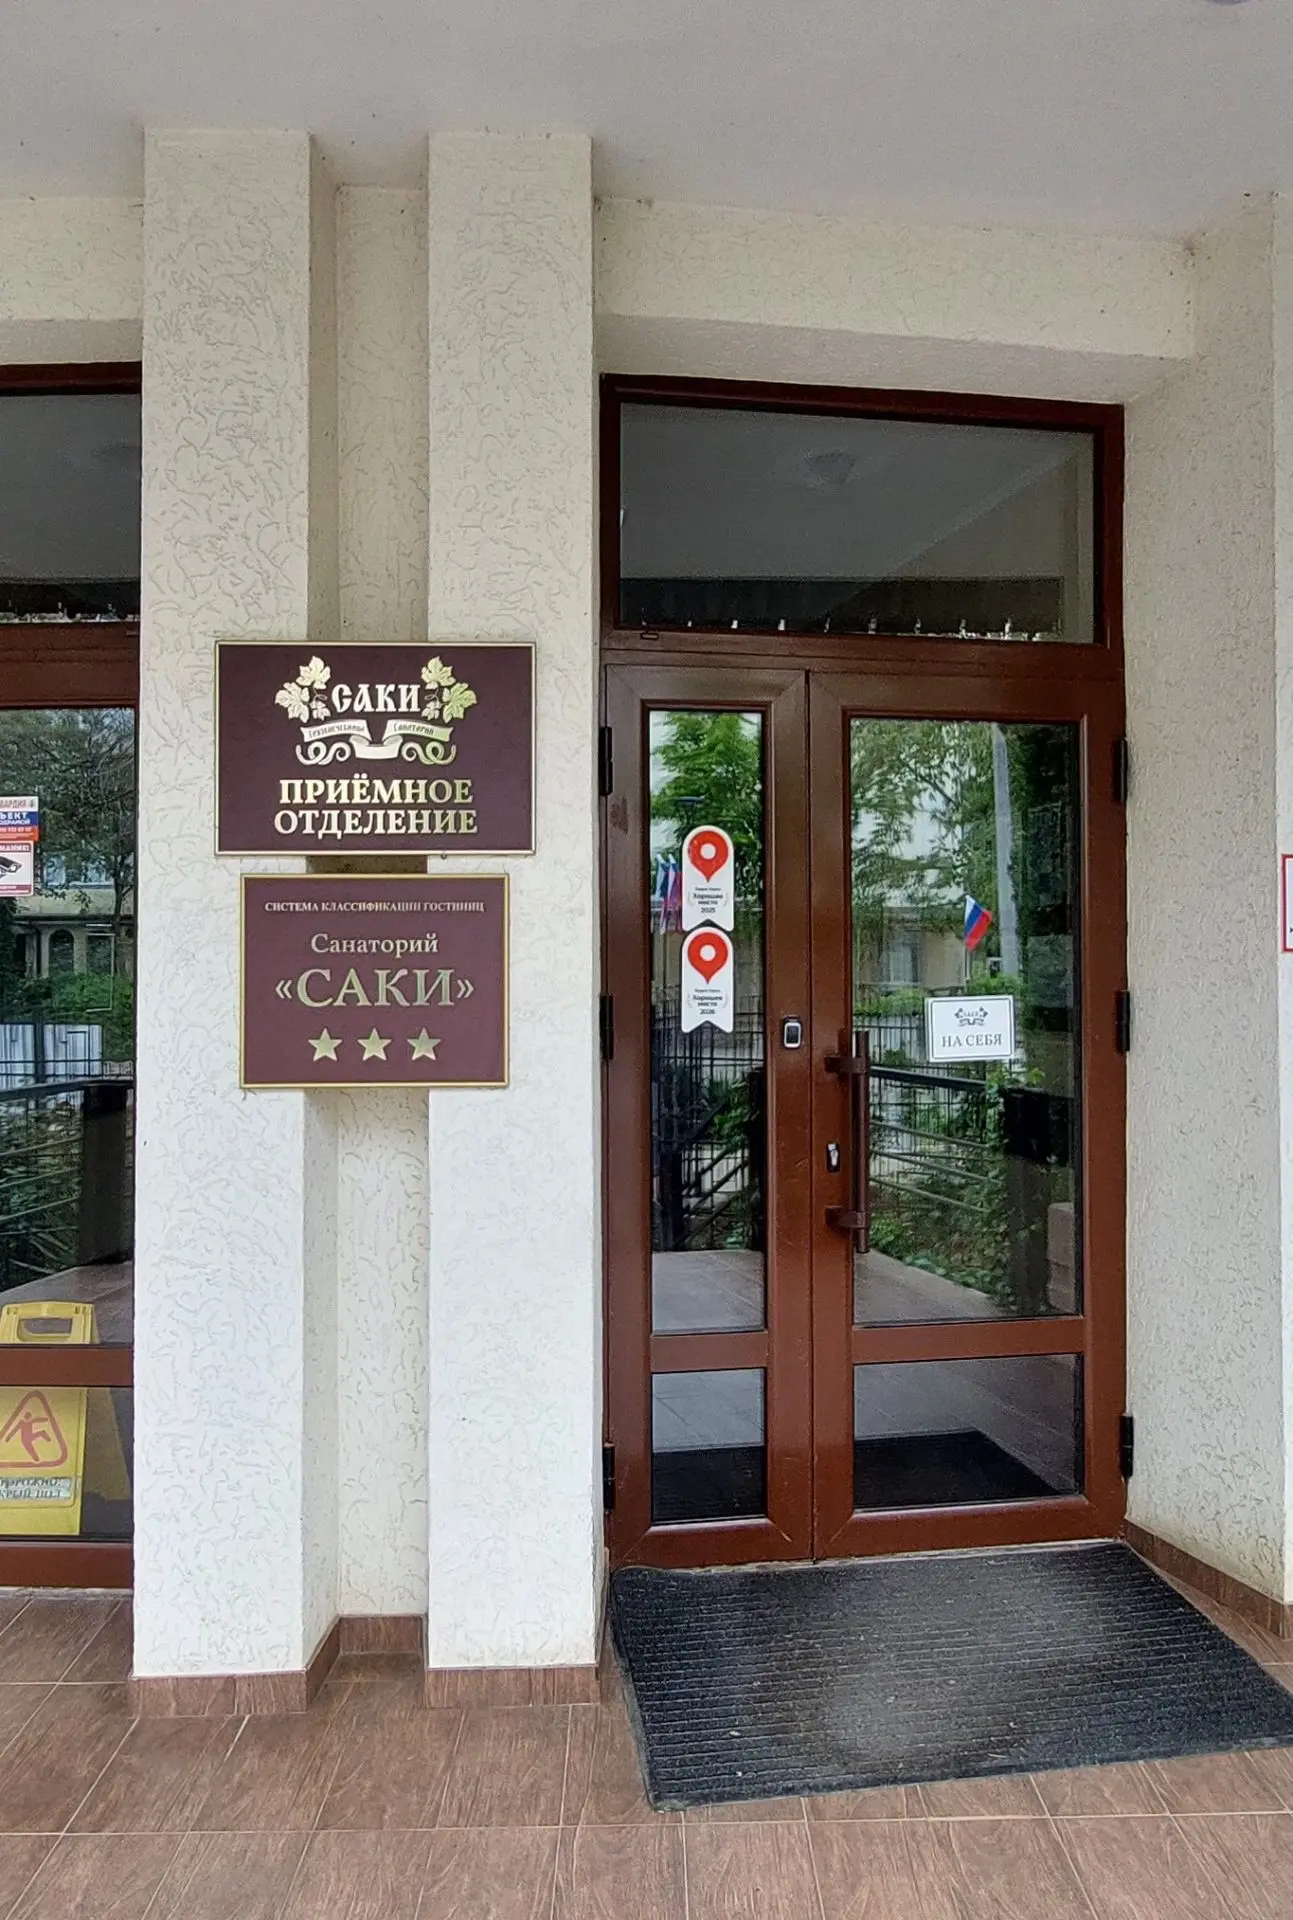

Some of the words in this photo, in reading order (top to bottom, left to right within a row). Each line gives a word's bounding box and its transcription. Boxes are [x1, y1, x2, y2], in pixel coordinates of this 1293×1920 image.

[331, 683, 421, 713] САКИ
[279, 773, 473, 805] ПРИЁМНОЕ
[274, 808, 478, 839] ОТДЕЛЕНИЕ
[264, 902, 319, 912] СИСТЕМА
[321, 902, 421, 912] КЛАССИФИКАЦИИ
[423, 902, 485, 913] ГОСТИНИЦ
[310, 932, 439, 958] Санаторий
[275, 968, 475, 1007] «САКИ»
[941, 1035, 962, 1048] НА
[965, 1033, 1002, 1046] СЕБЯ
